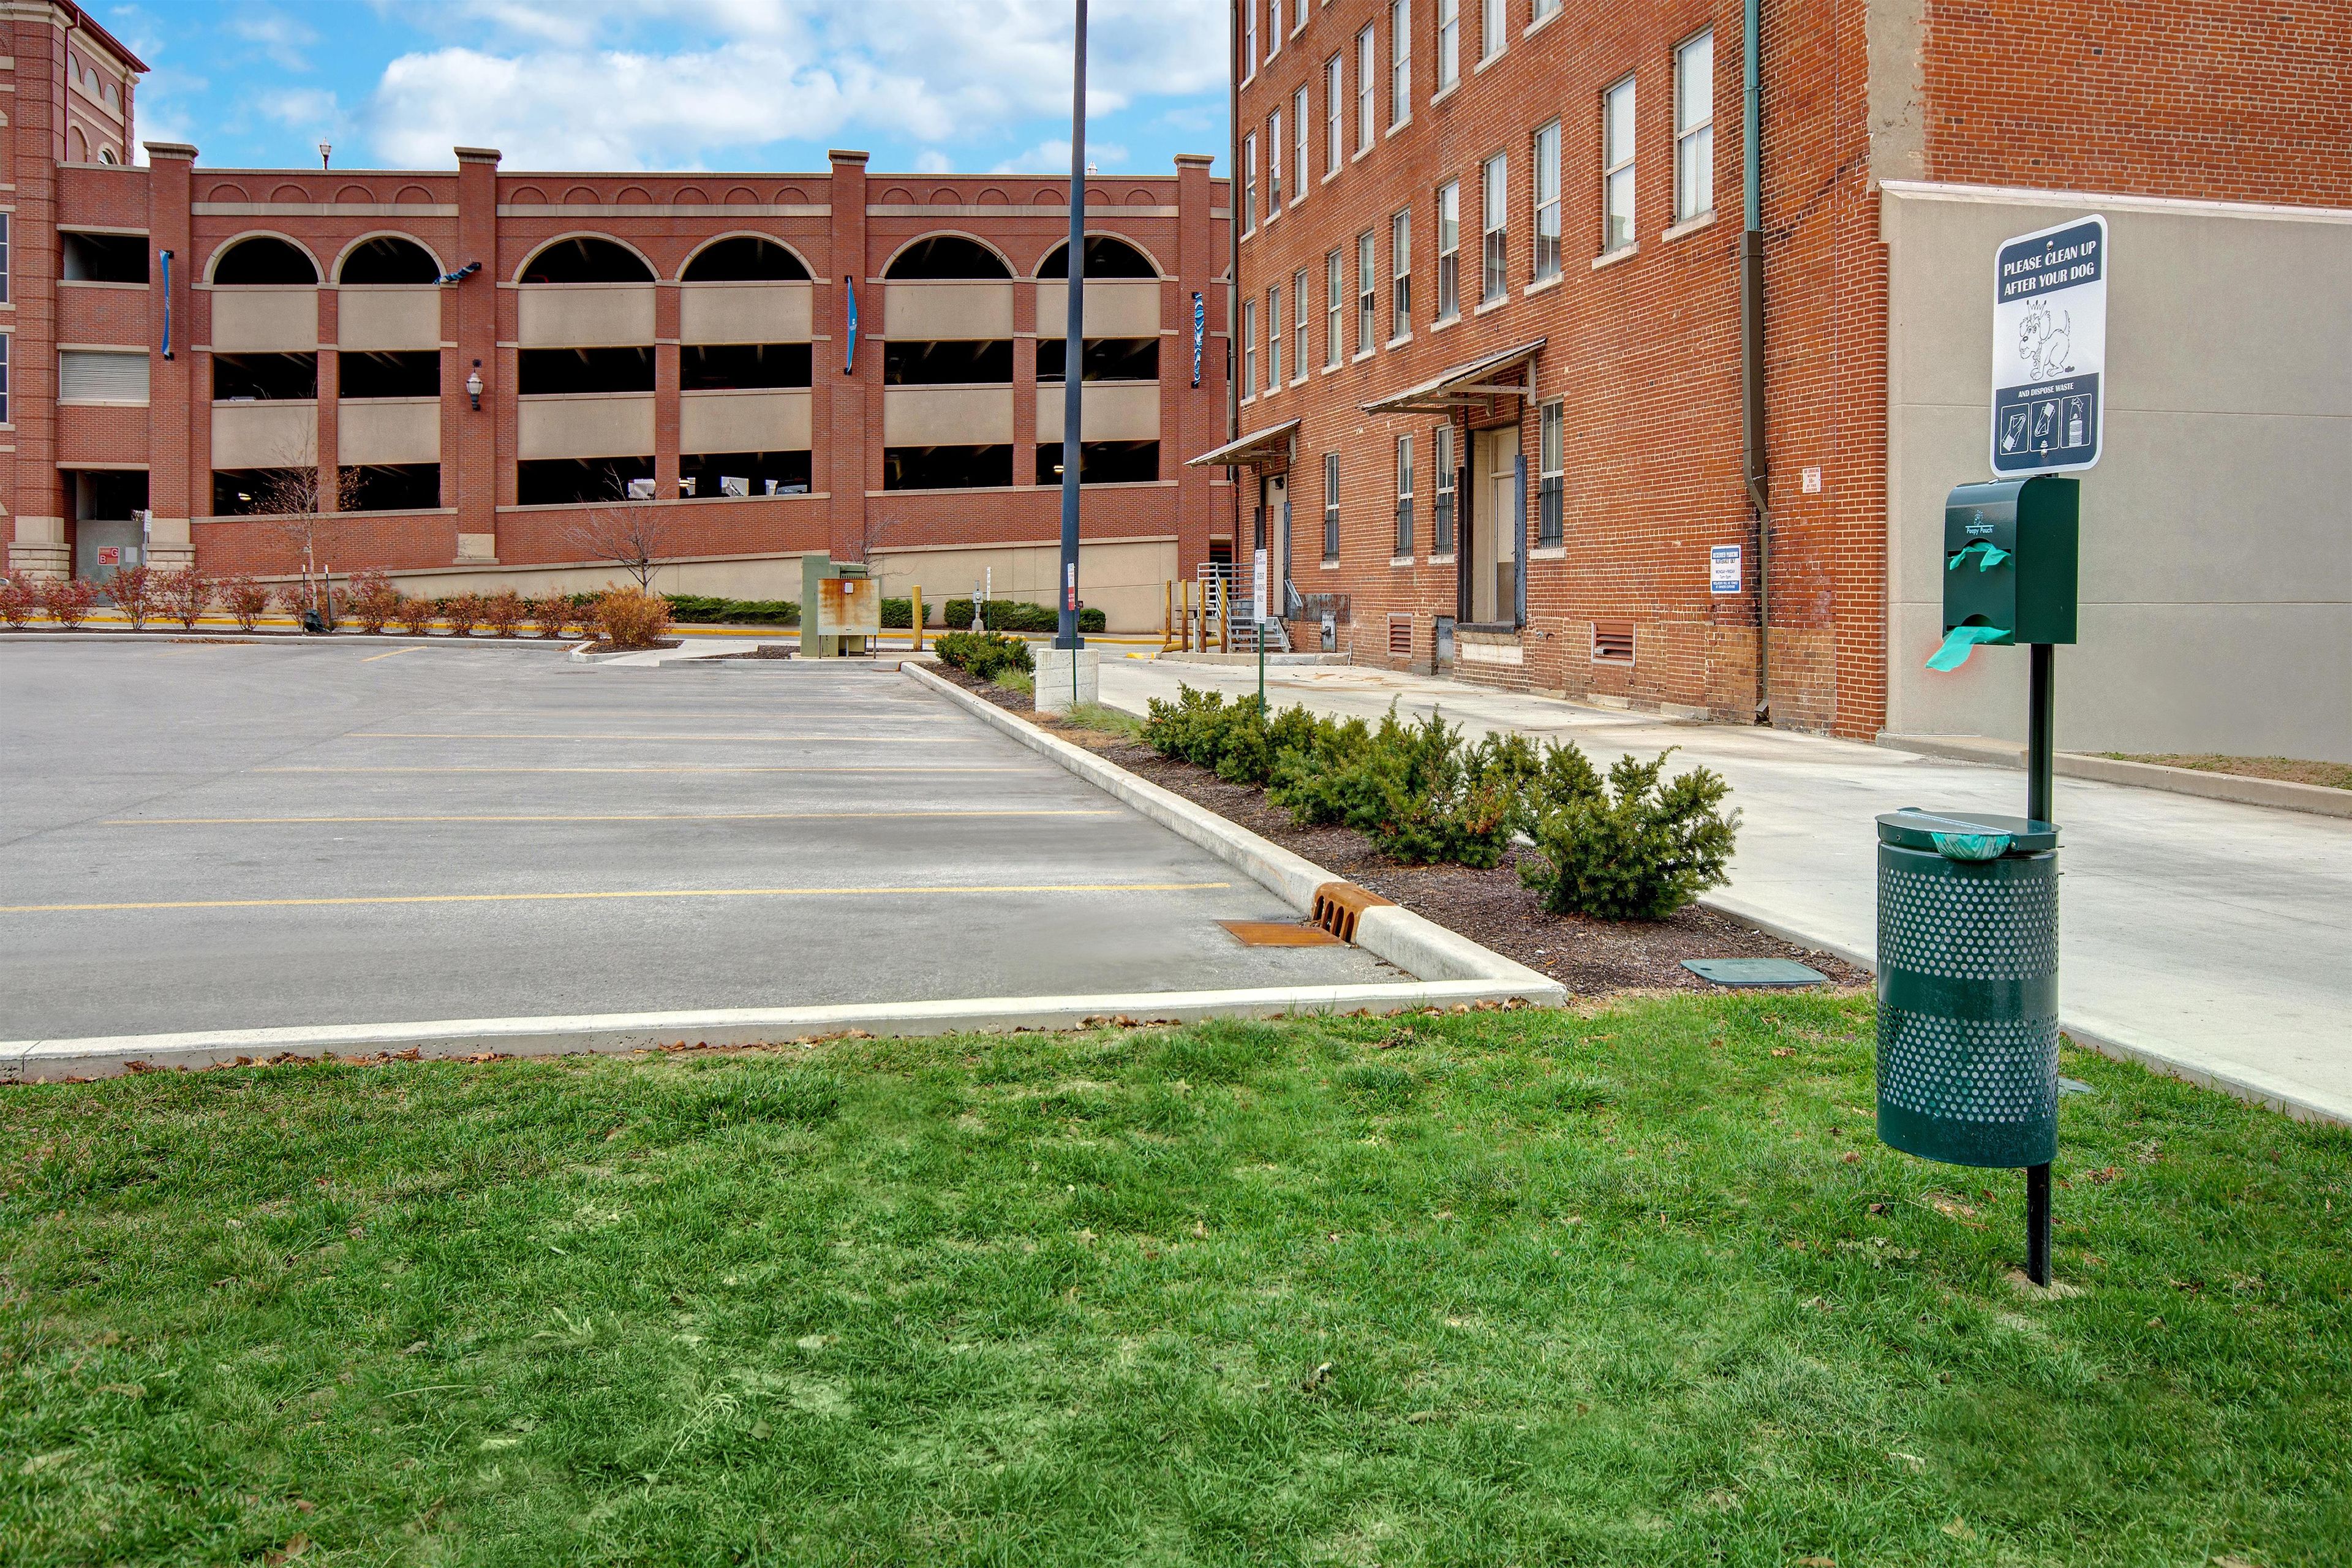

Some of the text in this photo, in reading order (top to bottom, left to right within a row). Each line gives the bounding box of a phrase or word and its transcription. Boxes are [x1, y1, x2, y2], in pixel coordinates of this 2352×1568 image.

[2003, 240, 2097, 277] PLEASE CLEAN UP
[2003, 262, 2095, 296] AFTER YOUR DOG
[2018, 382, 2075, 398] AND DISPOSE WASTE
[100, 555, 106, 564] B
[111, 548, 118, 557] G
